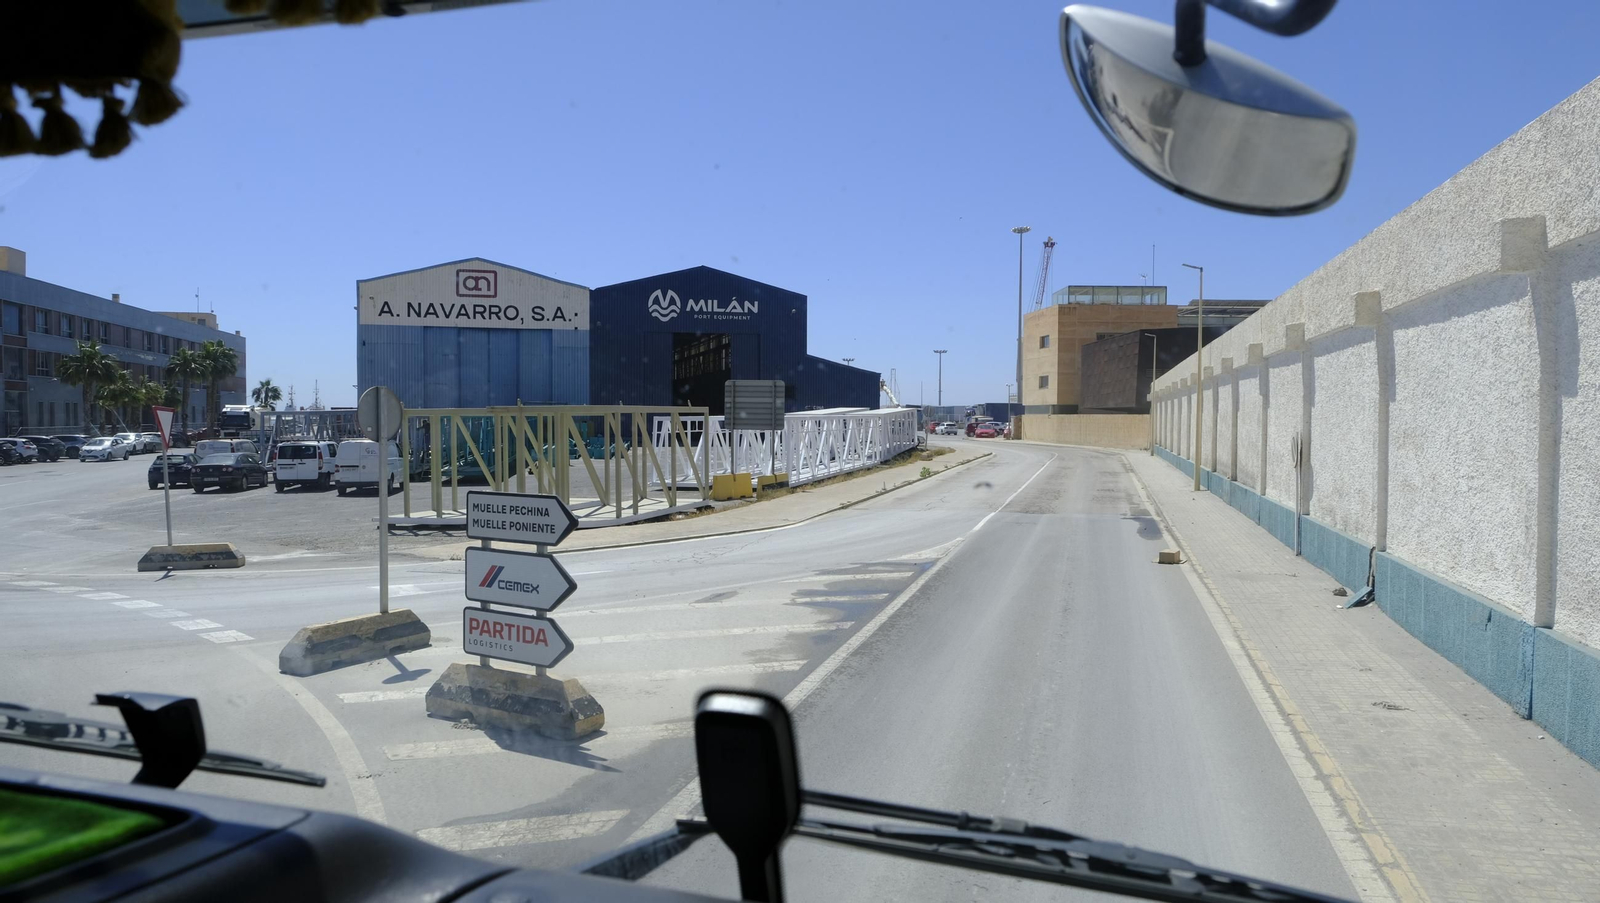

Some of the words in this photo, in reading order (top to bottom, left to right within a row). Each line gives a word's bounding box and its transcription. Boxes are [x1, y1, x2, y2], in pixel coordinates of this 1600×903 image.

[378, 301, 400, 317] A.
[407, 302, 525, 325] NAVARRO,
[686, 297, 758, 313] MILÁN
[472, 503, 507, 514] MUELLE
[509, 505, 550, 517] PECHINA
[472, 518, 507, 530] MUELLE
[509, 521, 556, 534] PONIENTE
[497, 580, 540, 594] CEMEX
[469, 617, 548, 647] PARTIDA
[468, 638, 514, 652] LOGISTICS
